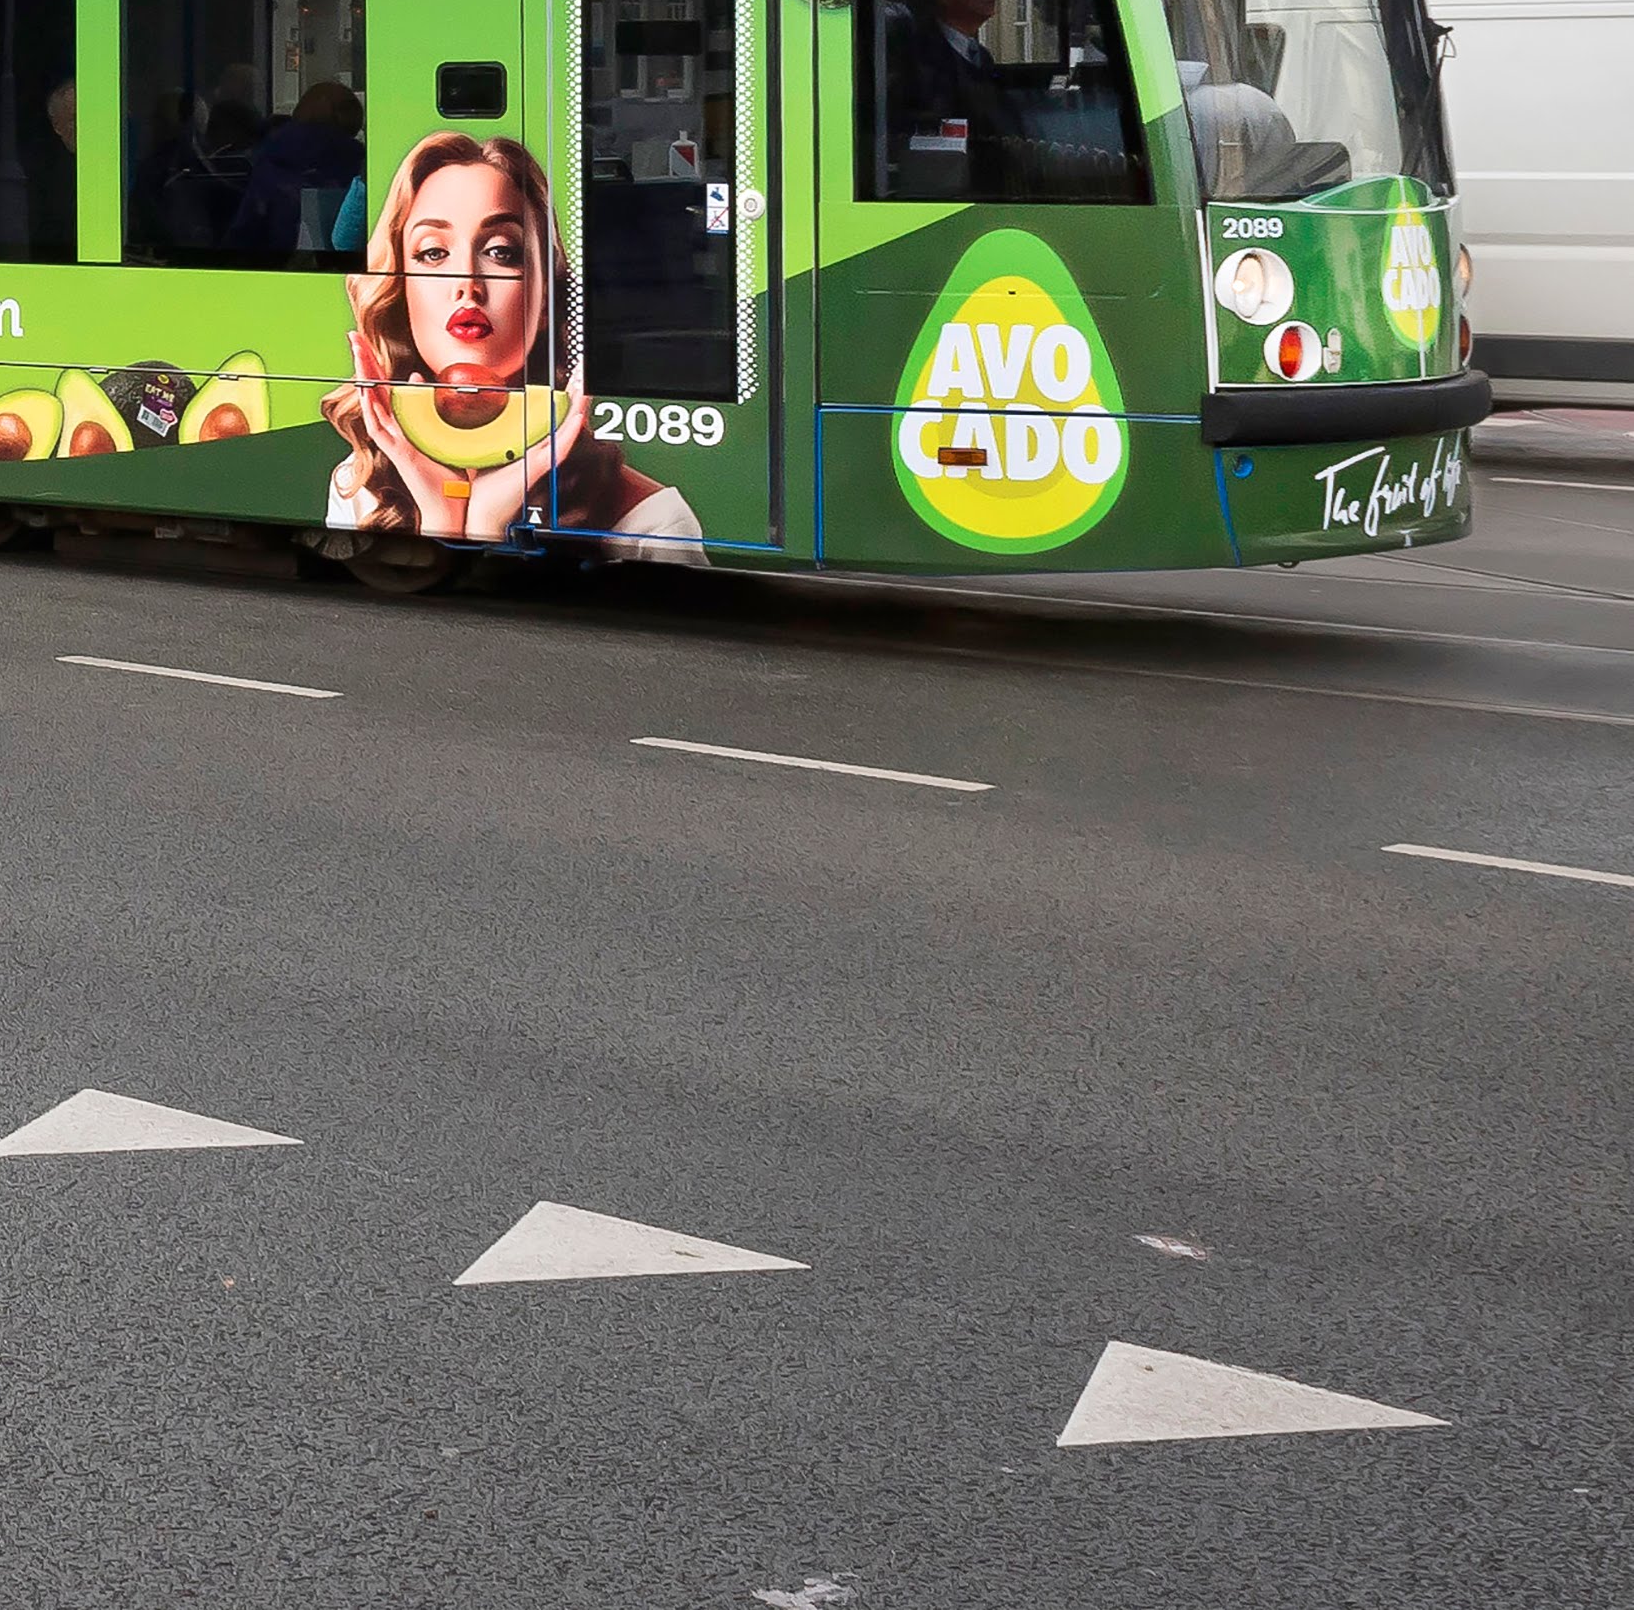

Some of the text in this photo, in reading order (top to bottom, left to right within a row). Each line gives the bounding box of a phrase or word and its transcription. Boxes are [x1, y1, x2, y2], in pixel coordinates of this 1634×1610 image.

[1222, 217, 1284, 239] 2089
[1389, 225, 1433, 267] AVO
[1383, 266, 1441, 311] CADO
[927, 322, 1092, 402] AVO
[593, 401, 726, 447] 2089
[898, 399, 1121, 484] CADO
[1315, 446, 1385, 530] The
[1364, 454, 1419, 537] fruit
